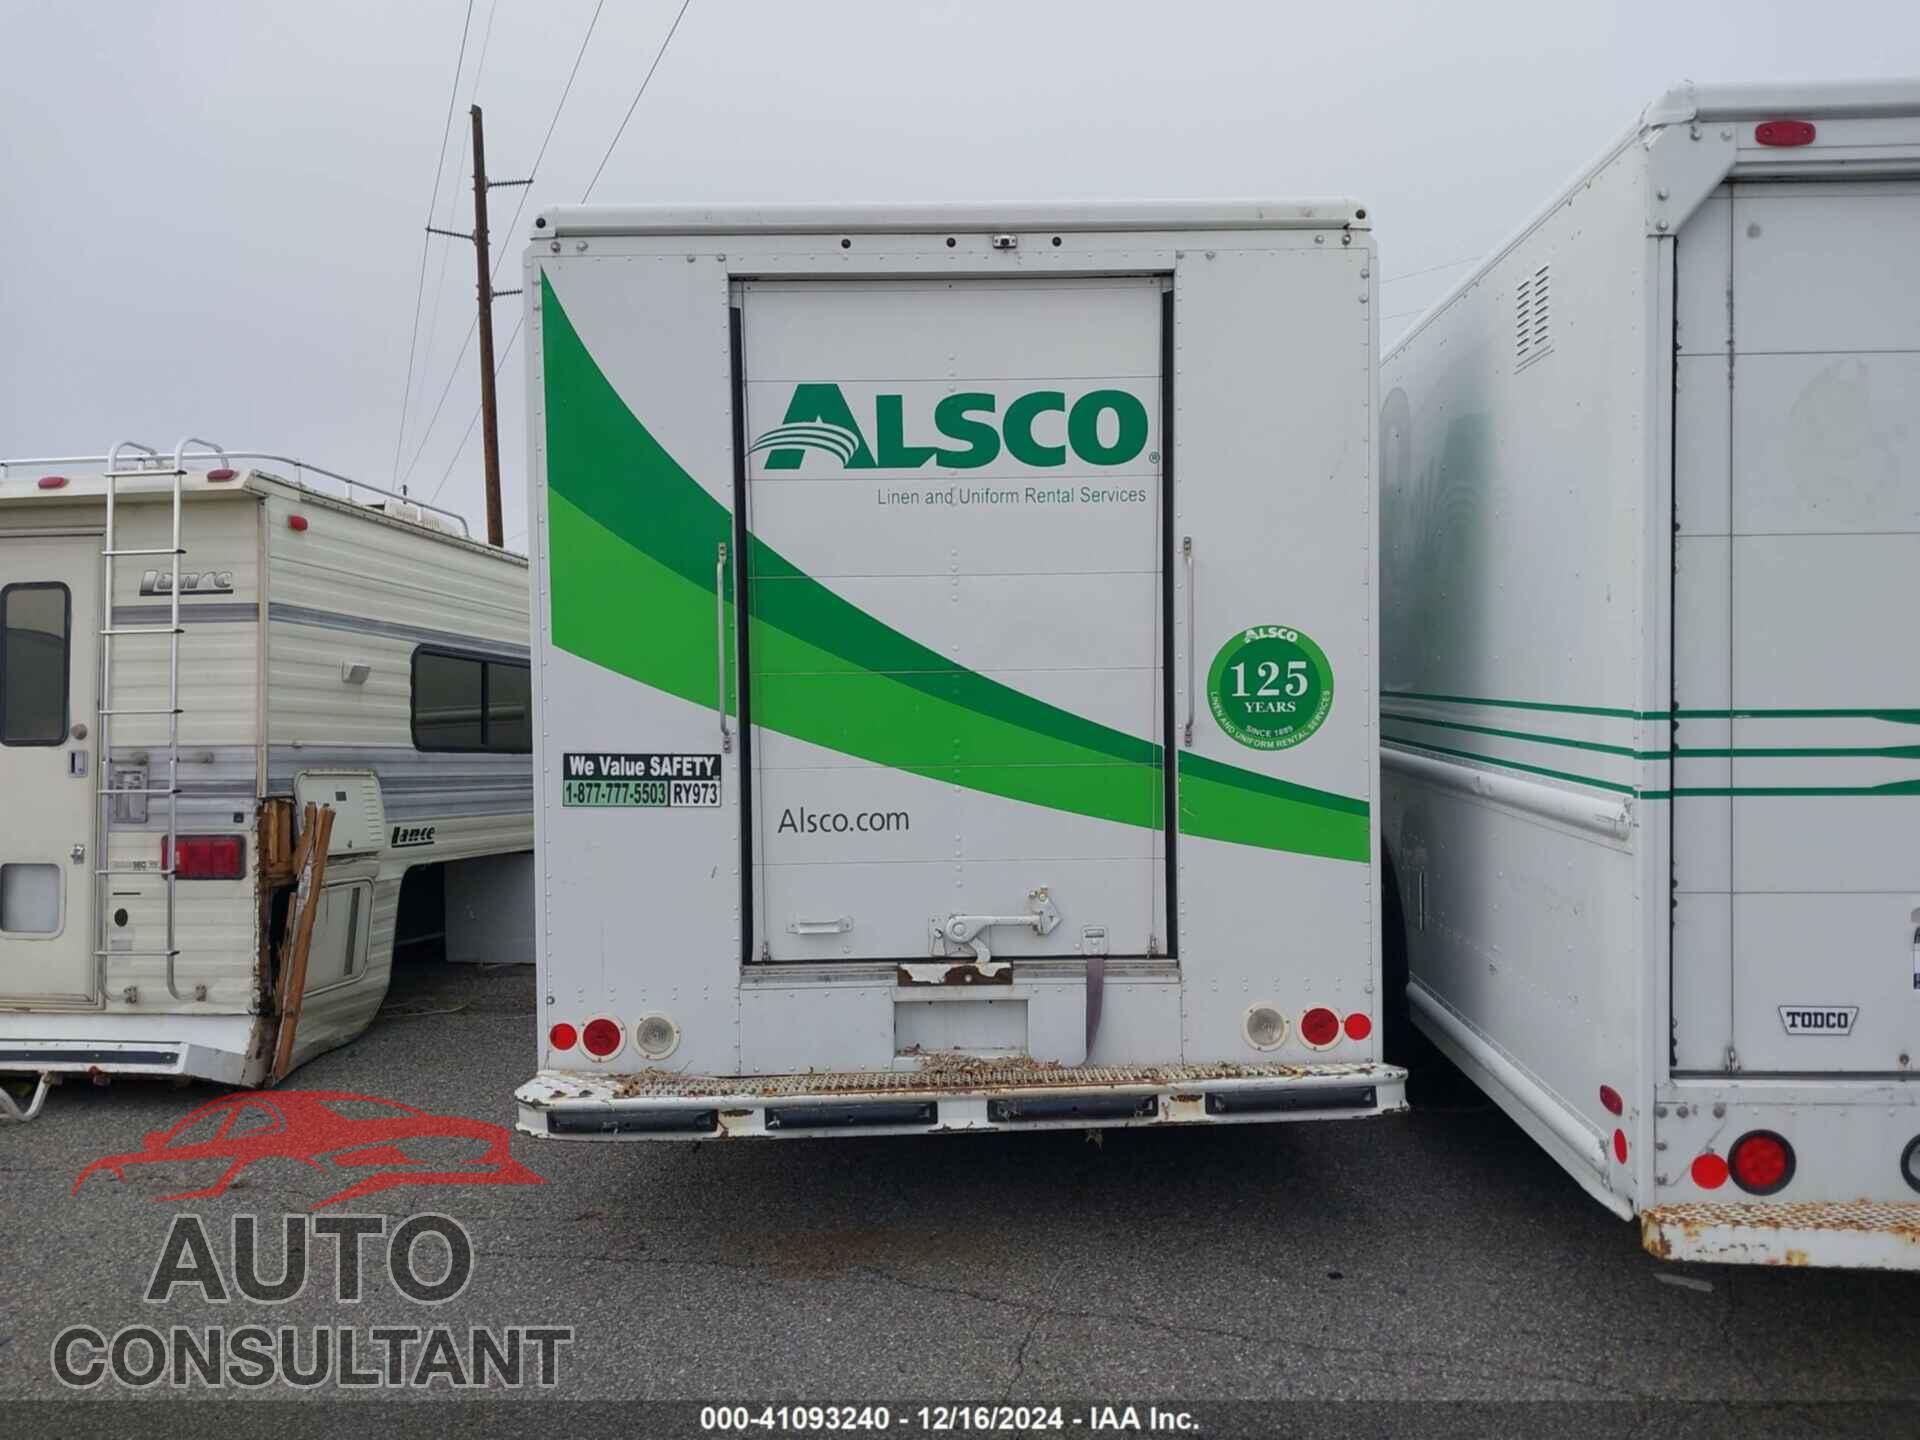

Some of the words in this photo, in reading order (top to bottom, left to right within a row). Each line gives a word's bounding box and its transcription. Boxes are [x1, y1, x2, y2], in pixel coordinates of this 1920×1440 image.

[745, 383, 1148, 470] ALSCO
[877, 488, 920, 504] Linen
[925, 488, 954, 504] and
[959, 487, 1020, 504] Uniform
[1025, 487, 1075, 504] Rental
[1079, 486, 1147, 503] Services
[1244, 627, 1298, 643] ALSCO
[1230, 660, 1309, 697] 125
[1244, 701, 1297, 713] YEARS
[569, 755, 595, 776] We
[599, 756, 645, 776] Value
[650, 756, 715, 776] SAFETY
[673, 783, 718, 804] RY973
[777, 806, 910, 834] Alsco.com
[1786, 1011, 1848, 1028] TODCO
